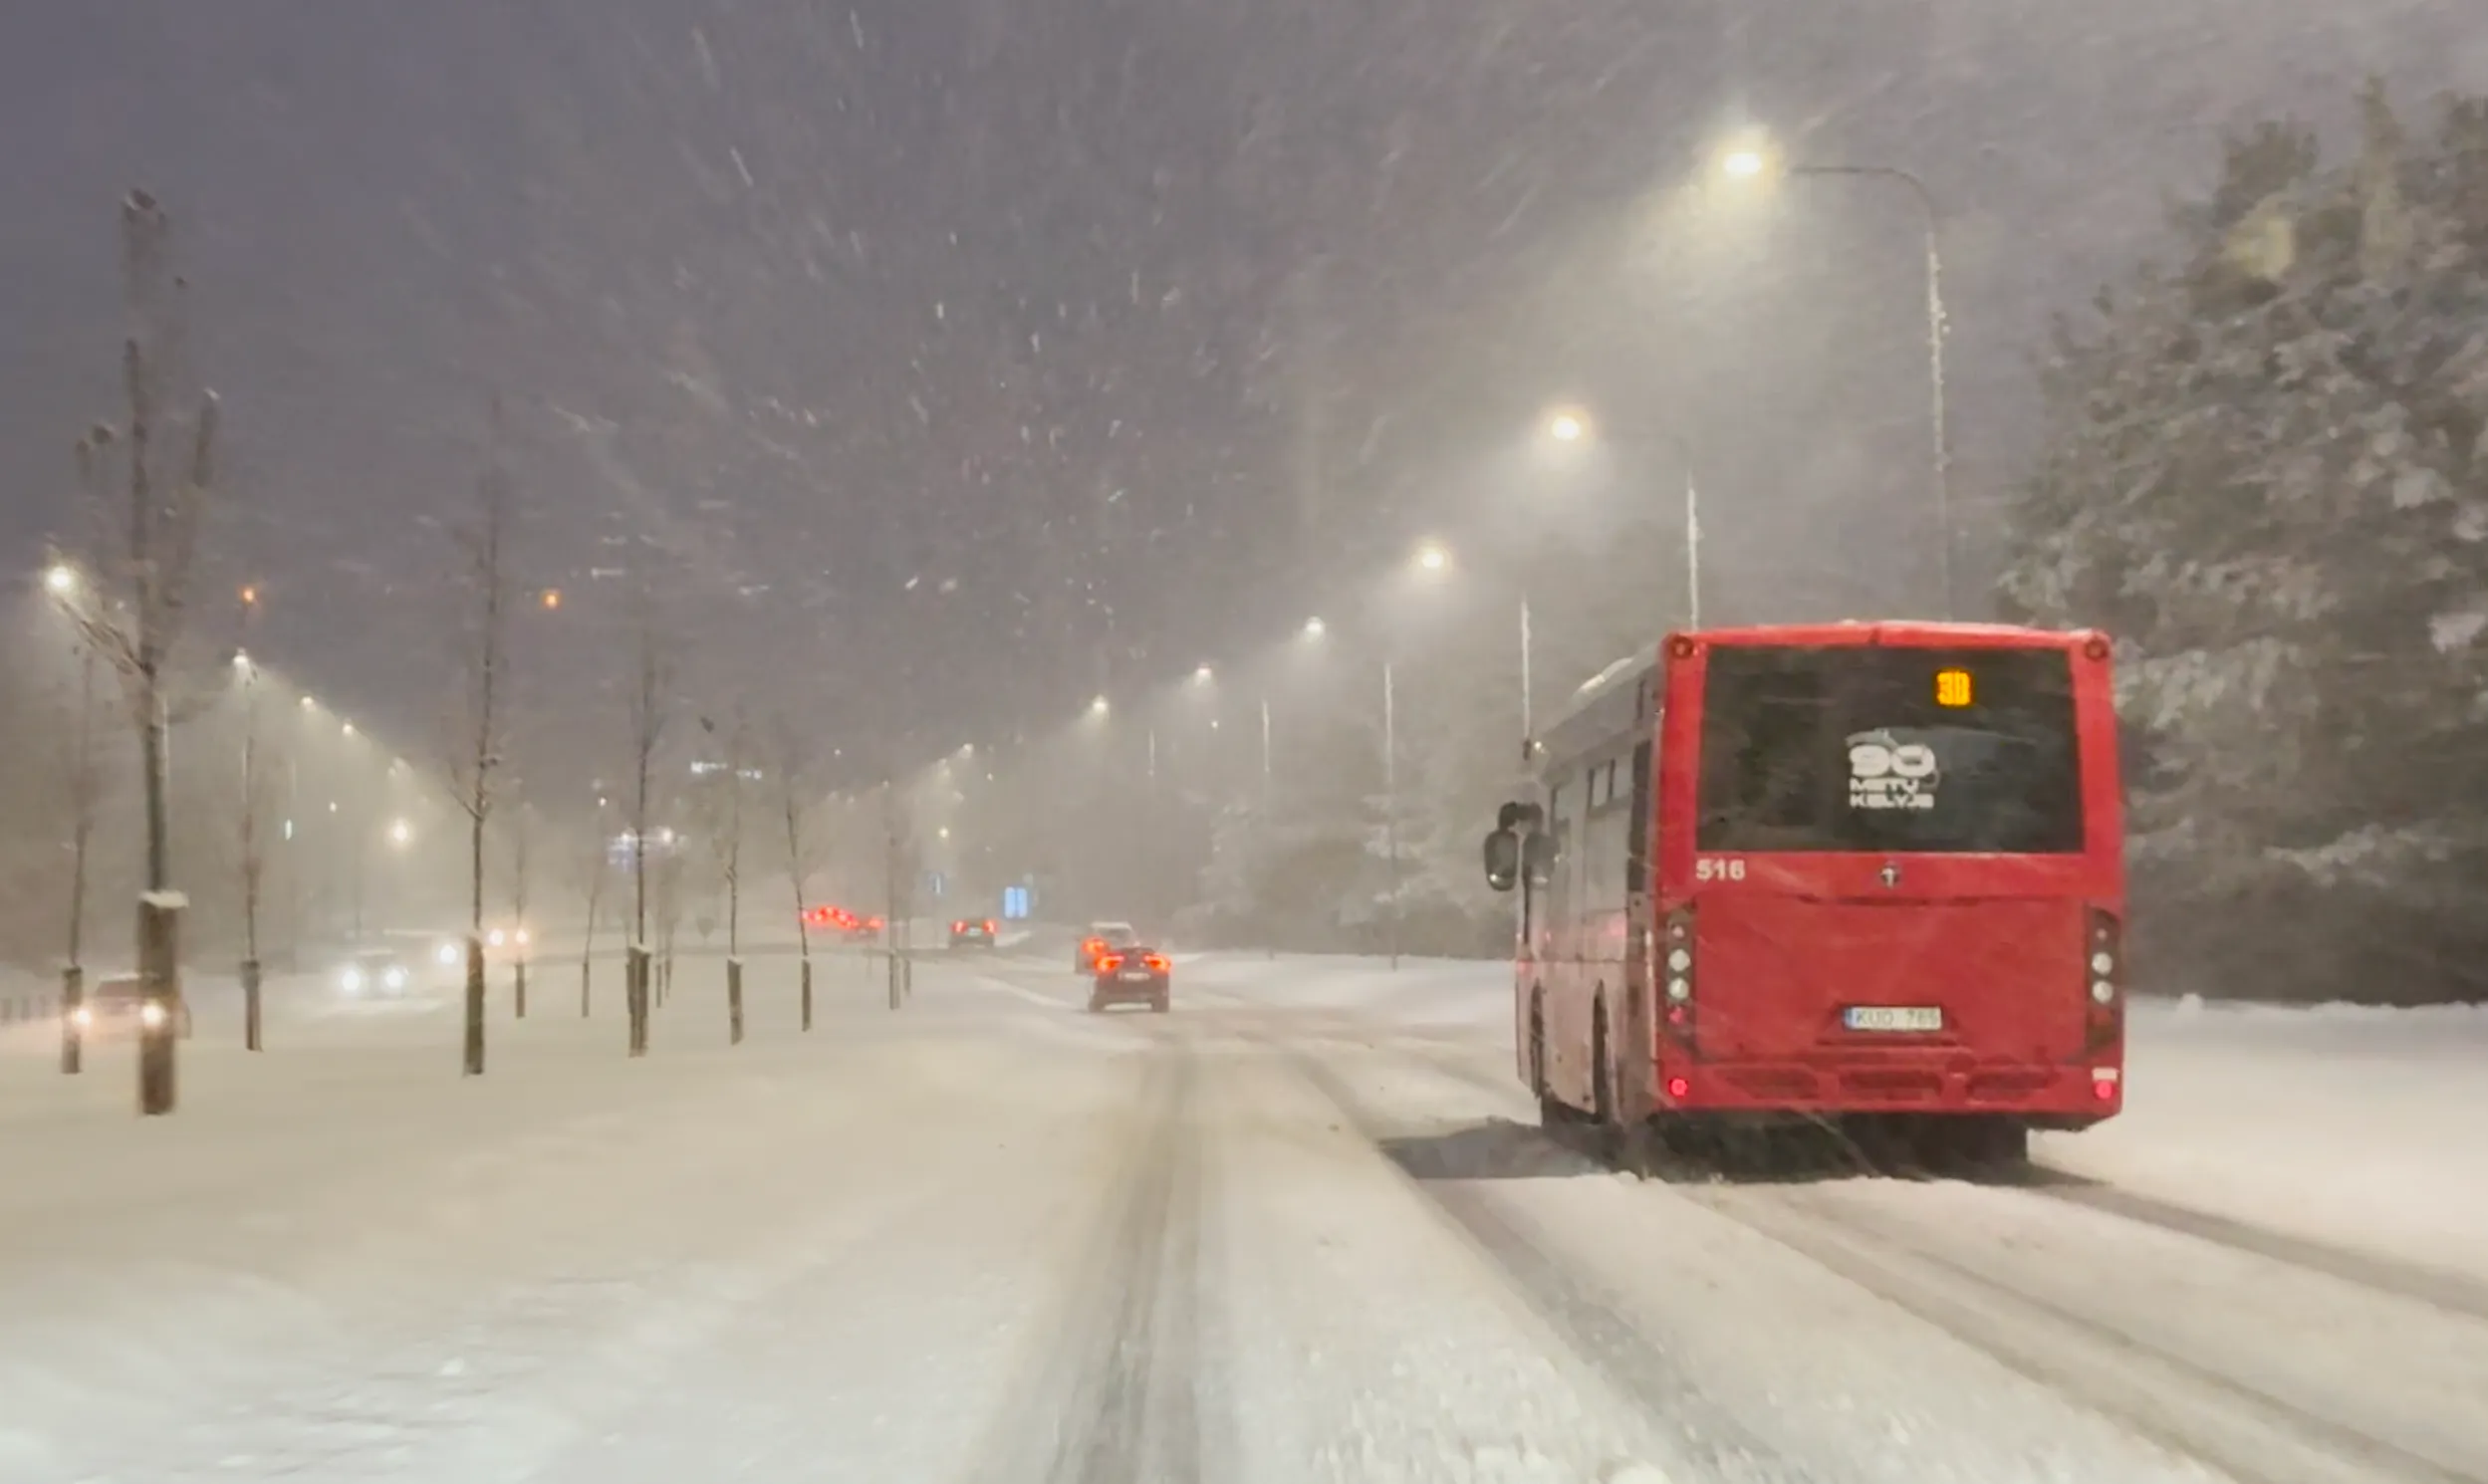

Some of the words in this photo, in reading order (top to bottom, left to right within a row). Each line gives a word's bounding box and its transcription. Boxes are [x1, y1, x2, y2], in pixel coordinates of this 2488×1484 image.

[1936, 671, 1971, 705] 30
[1850, 744, 1936, 777] 90
[1695, 859, 1746, 881] 516
